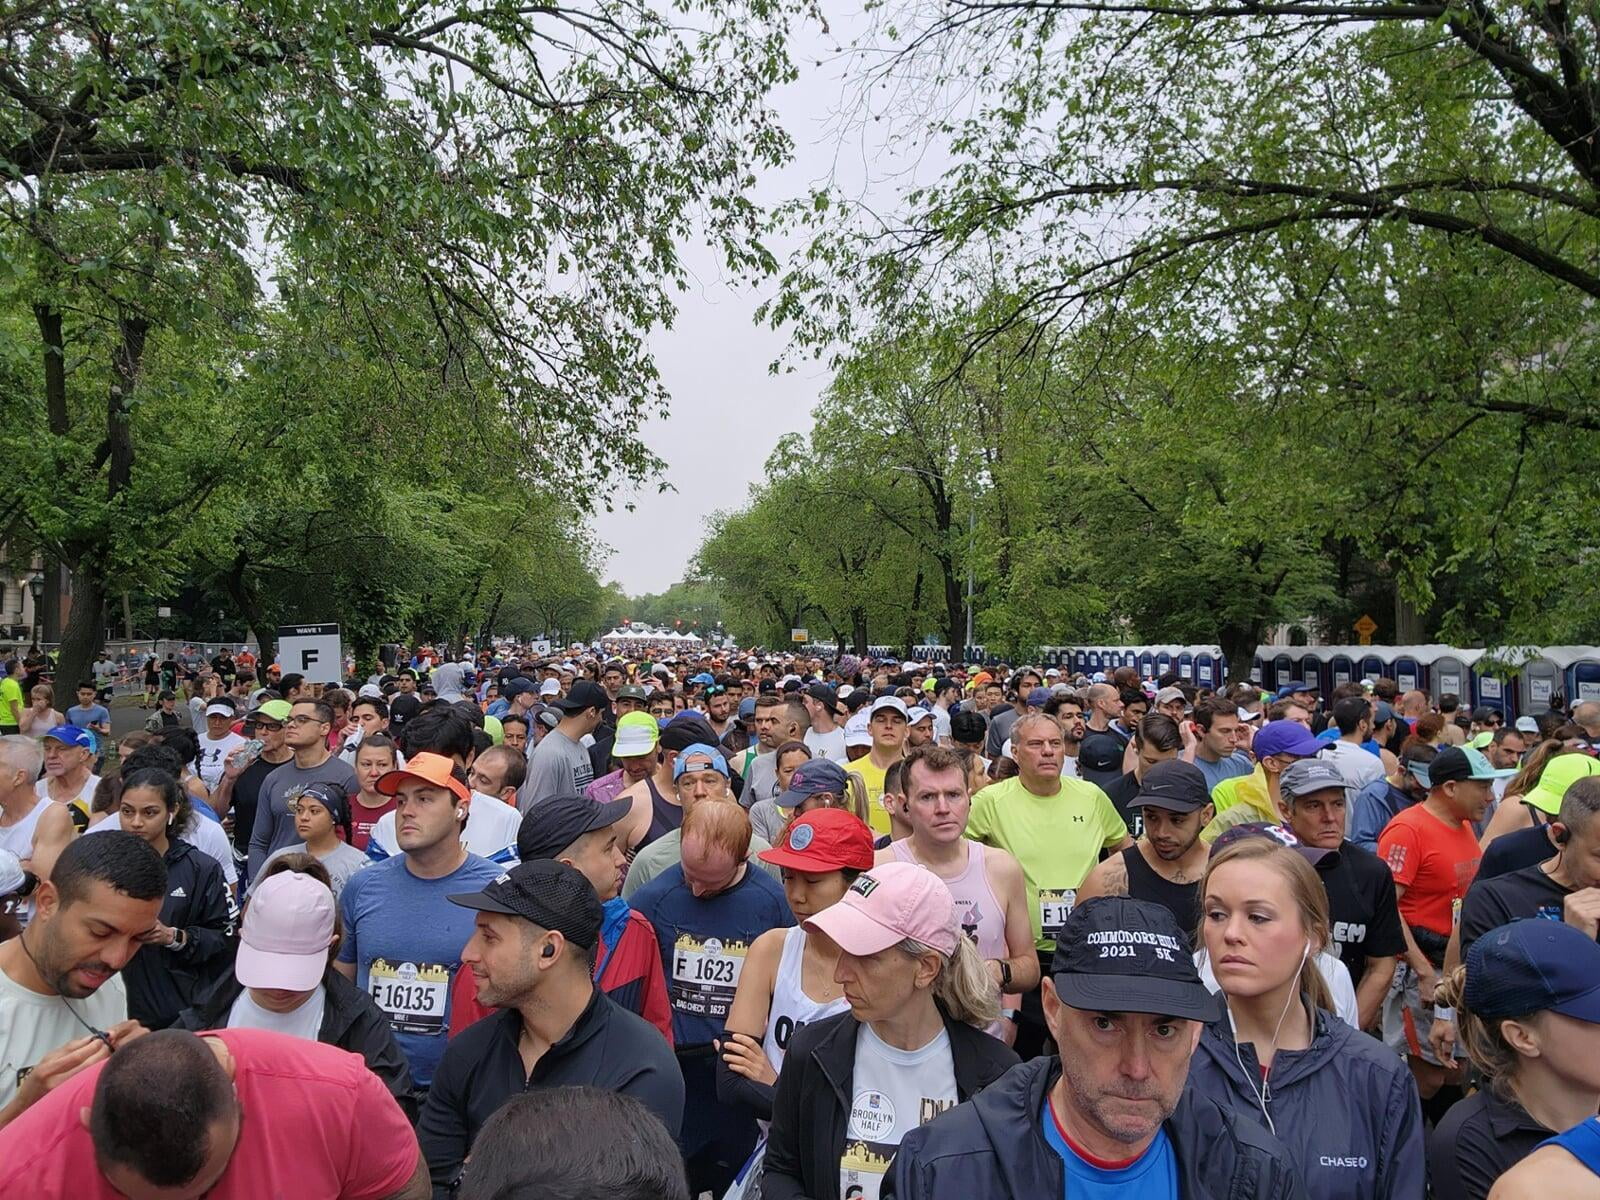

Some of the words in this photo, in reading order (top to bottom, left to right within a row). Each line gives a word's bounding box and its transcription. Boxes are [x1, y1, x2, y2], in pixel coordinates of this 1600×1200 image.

[301, 649, 319, 671] F
[1043, 908, 1052, 923] F
[1057, 906, 1074, 923] 11
[1087, 930, 1158, 945] COMMODORE
[1329, 921, 1366, 943] EM
[1099, 945, 1137, 958] 2021
[1154, 947, 1175, 962] 5K
[676, 958, 688, 976] F
[694, 958, 735, 983] 1623
[372, 985, 383, 1002] F
[384, 984, 436, 1011] 16135
[687, 1002, 706, 1013] CHECK
[709, 1004, 726, 1015] 1623
[852, 1108, 893, 1123] BROOKLYN
[861, 1118, 882, 1132] HALF
[1320, 1156, 1358, 1167] CHASE
